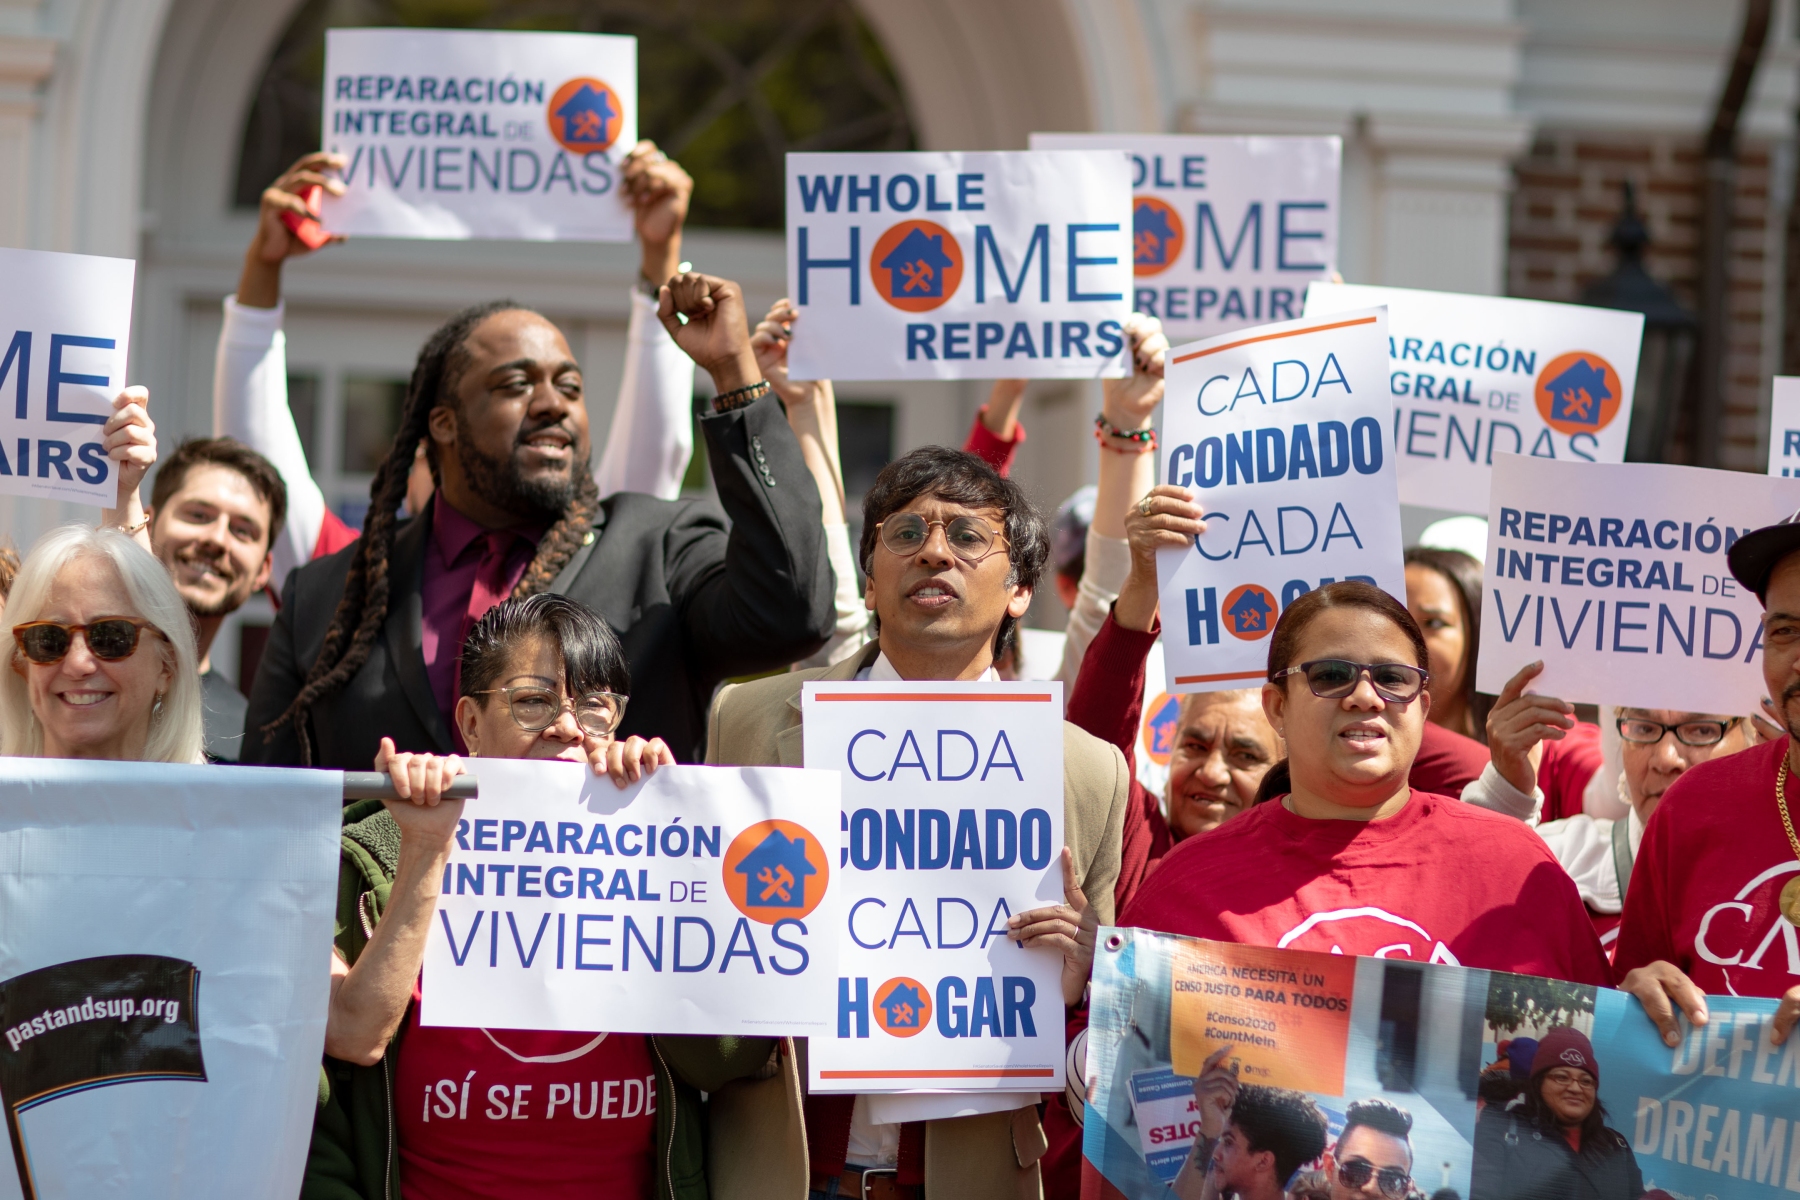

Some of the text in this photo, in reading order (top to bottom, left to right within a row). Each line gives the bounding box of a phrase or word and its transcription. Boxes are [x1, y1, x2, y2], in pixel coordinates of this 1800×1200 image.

[335, 73, 544, 104] REPARACIÓN
[333, 110, 535, 140] INTEGRAL DE
[331, 145, 613, 195] VIVIENDAS
[797, 173, 985, 213] WHOLE
[1134, 286, 1309, 321] REPAIR
[906, 321, 1124, 361] REPAIRS
[1197, 352, 1353, 416] CADA
[1390, 371, 1521, 413] GRAL DE
[1168, 416, 1384, 489] CONDADO
[1194, 502, 1363, 562] CADA
[1496, 547, 1737, 599] INTEGRAL DE
[847, 729, 1025, 782] CADA
[455, 817, 721, 858] REPARACIÓN
[841, 808, 1052, 870] ONDADO
[442, 862, 708, 903] INTEGRAL DE
[438, 909, 811, 976] VIVIENDAS
[848, 897, 1025, 950] CADA
[1174, 979, 1348, 1012] CENSO JUSTO PARA TODOS
[1231, 966, 1298, 985] NECESITA
[1303, 973, 1326, 988] UN
[5, 996, 180, 1051] pastandsup.org
[1206, 1011, 1277, 1032] #Censo2020
[423, 1070, 477, 1122] ¡SÍ
[485, 1084, 533, 1120] SE
[1149, 1120, 1201, 1144] OTES
